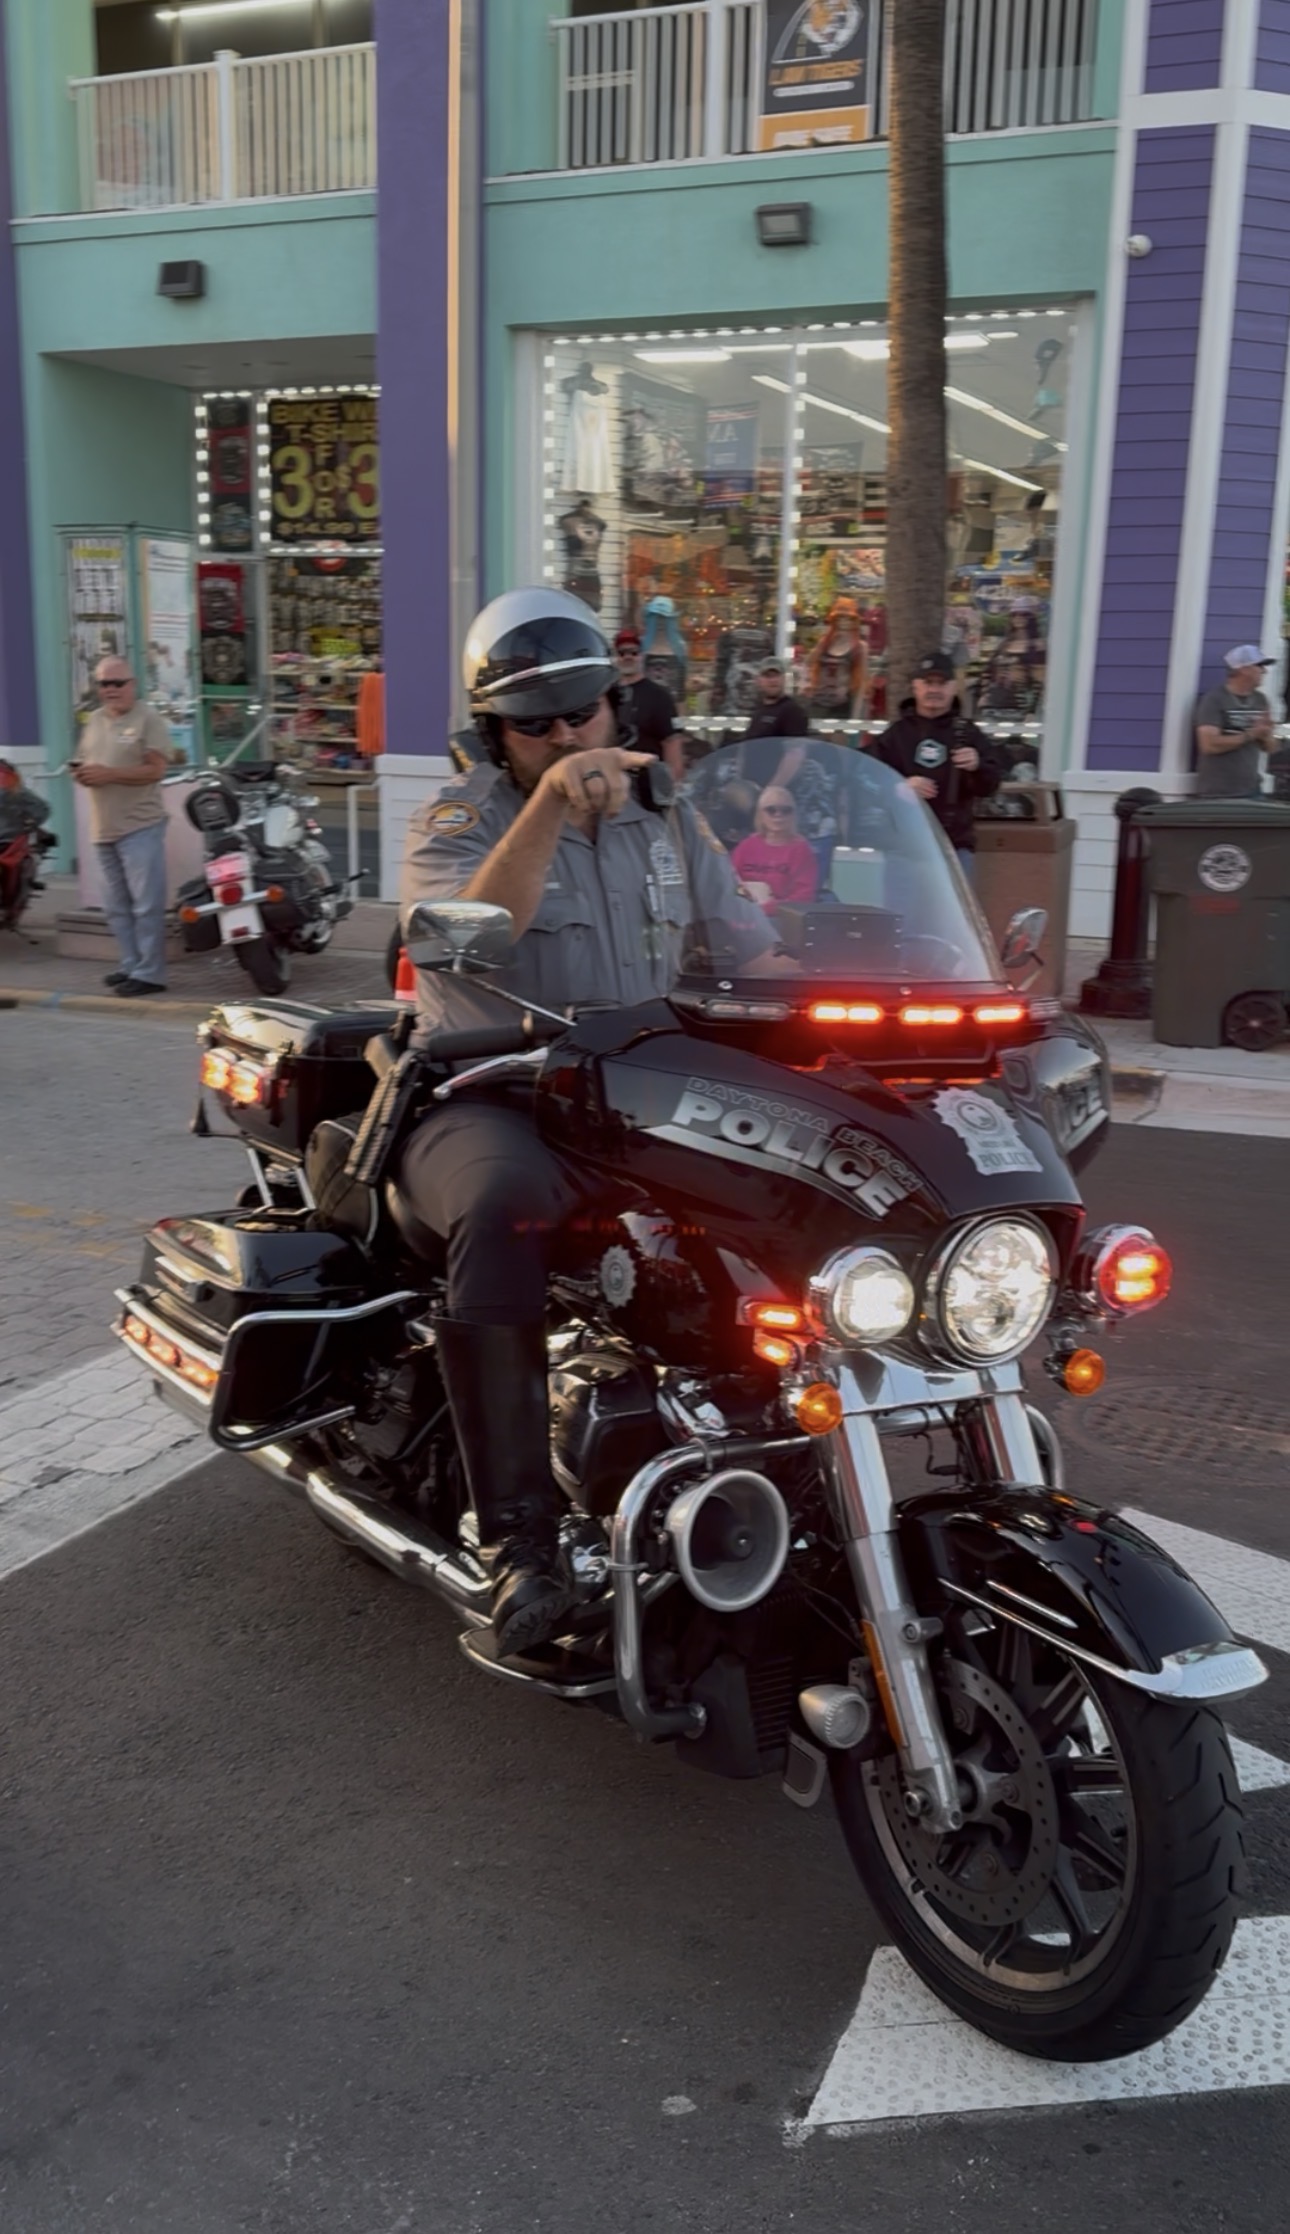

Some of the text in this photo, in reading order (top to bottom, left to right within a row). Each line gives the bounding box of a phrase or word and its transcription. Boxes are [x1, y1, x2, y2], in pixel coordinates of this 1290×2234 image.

[271, 402, 340, 424] BIKE
[284, 421, 378, 443] T-SHIR
[271, 444, 314, 518] 3
[671, 1091, 909, 1217] POLICE
[686, 1077, 923, 1193] DAYTONA BEACH
[977, 1151, 1035, 1168] POLICE
